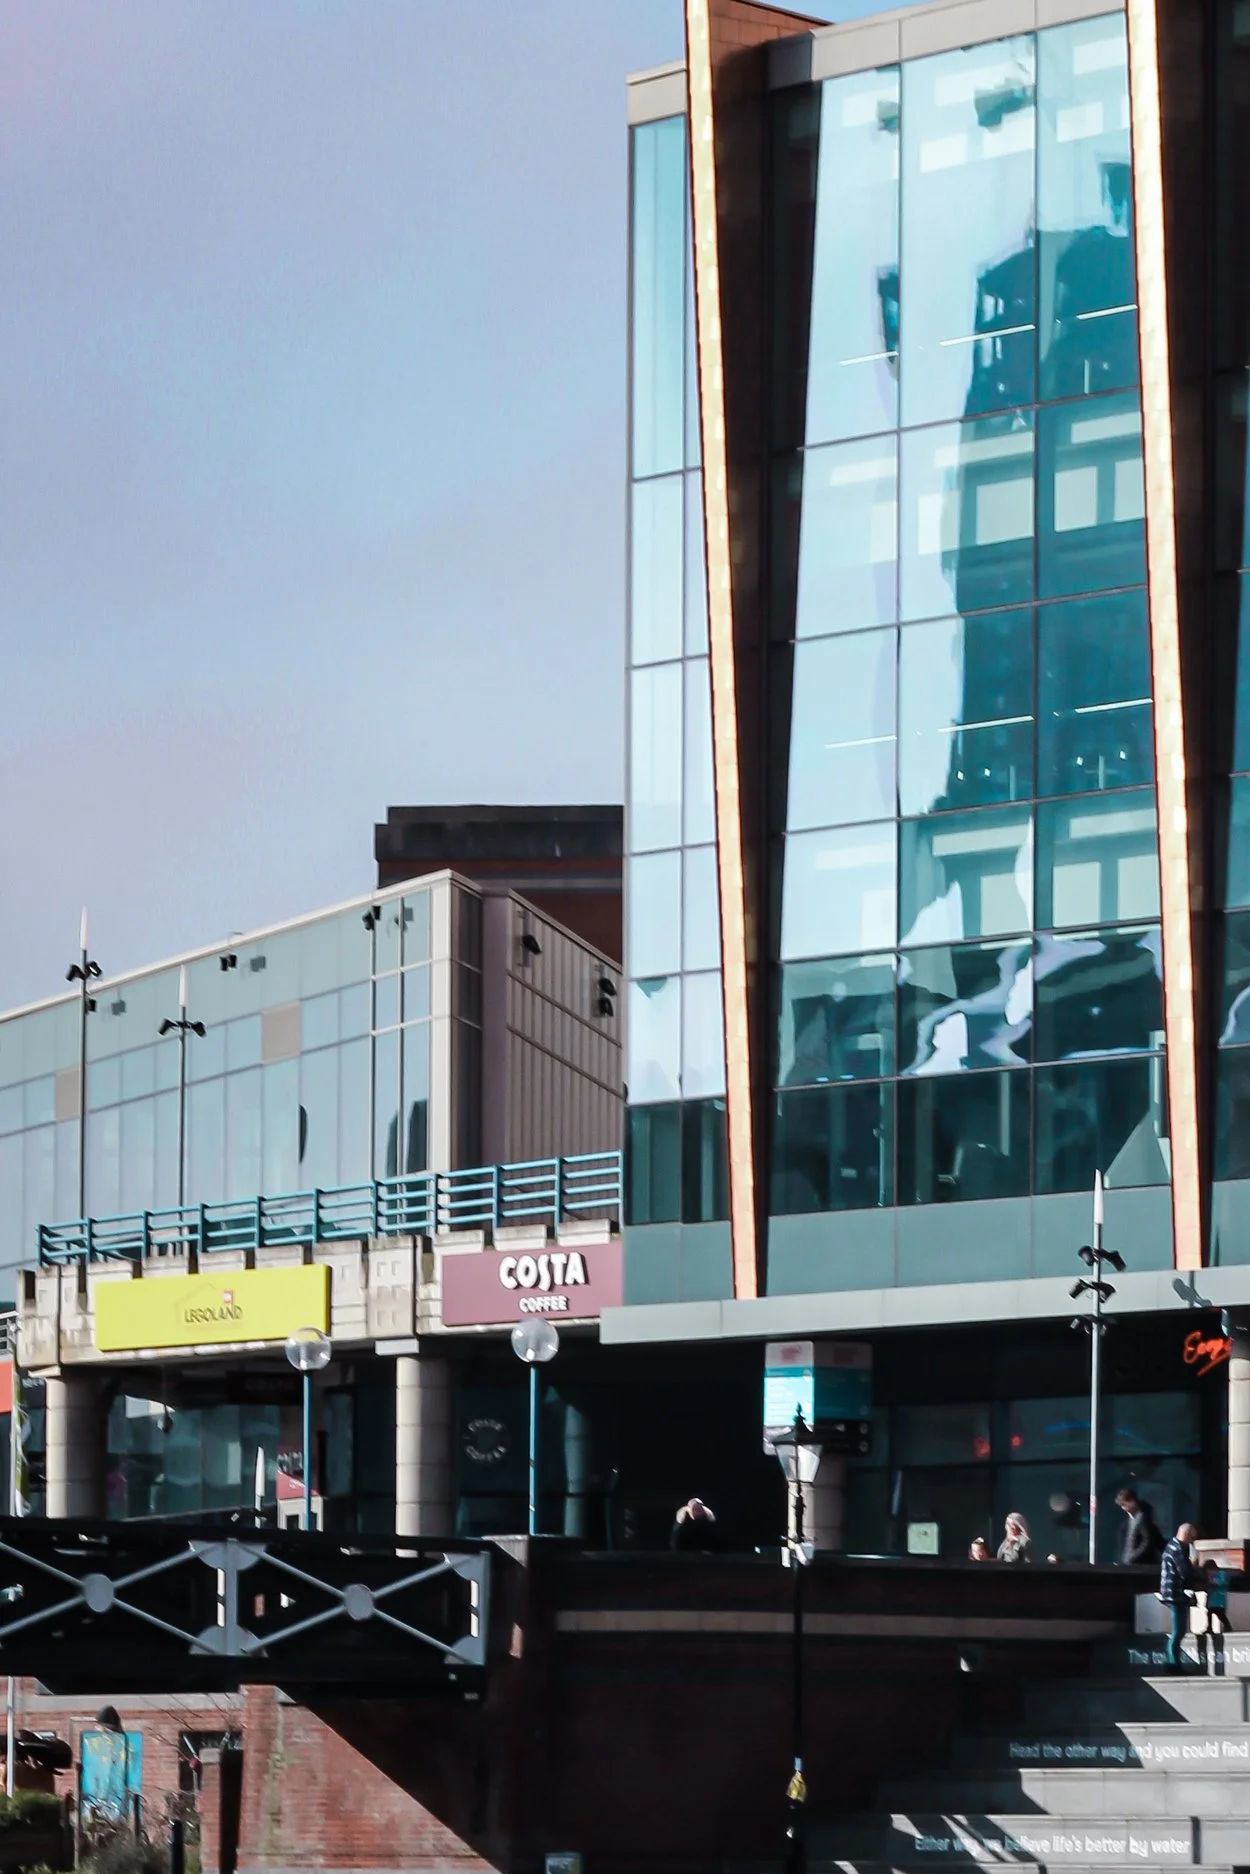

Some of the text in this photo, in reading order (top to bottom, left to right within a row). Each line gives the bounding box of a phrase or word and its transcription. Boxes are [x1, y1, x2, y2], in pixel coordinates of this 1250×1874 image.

[499, 1252, 587, 1291] COSTA
[519, 1296, 567, 1312] COFFEE
[184, 1305, 243, 1324] LEGOLAND
[1128, 1649, 1149, 1664] The
[1043, 1742, 1062, 1758] the
[1065, 1742, 1098, 1758] other
[1100, 1745, 1126, 1762] way
[1128, 1742, 1151, 1758] and
[1154, 1744, 1179, 1762] you
[1182, 1741, 1219, 1758] could
[1222, 1741, 1248, 1758] find
[915, 1835, 949, 1851] Either
[1004, 1835, 1050, 1853] believe
[1053, 1835, 1083, 1853] life's
[1085, 1835, 1126, 1853] better
[1129, 1836, 1148, 1857] by
[1151, 1837, 1190, 1853] water
